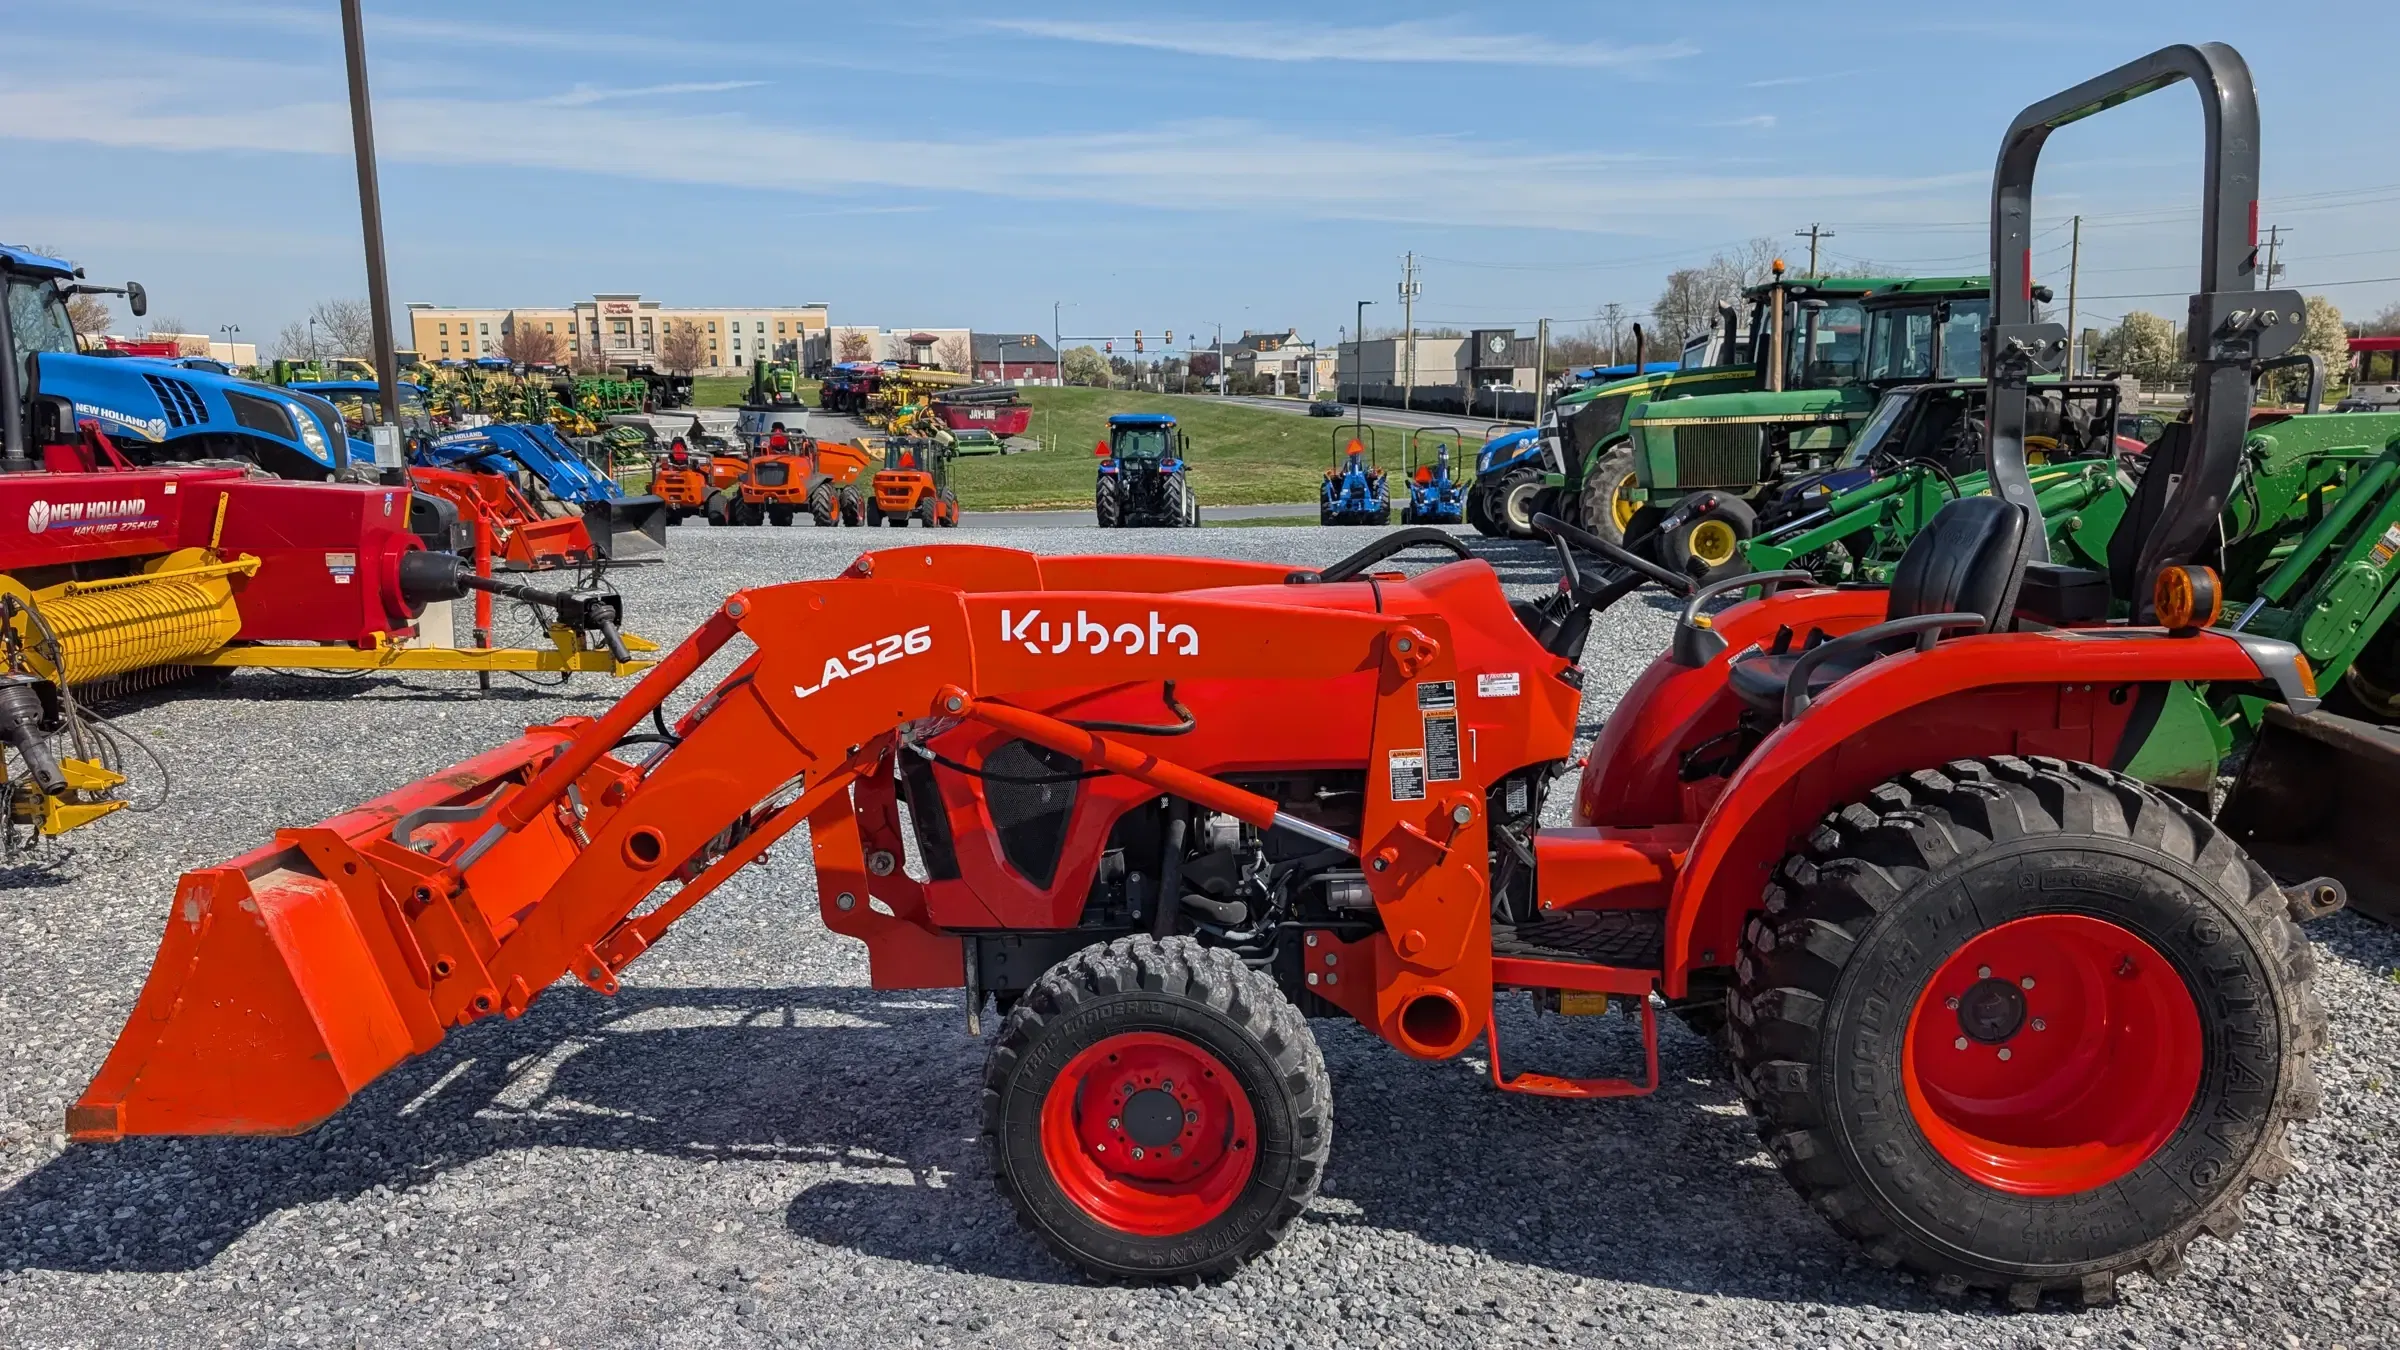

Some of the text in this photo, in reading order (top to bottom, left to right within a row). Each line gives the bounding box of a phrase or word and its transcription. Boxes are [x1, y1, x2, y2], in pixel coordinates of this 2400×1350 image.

[75, 402, 148, 429] NEW HOLLAND
[969, 409, 996, 420] JAY-LOR
[440, 431, 483, 443] NEW HOLLAND
[50, 499, 146, 521] NEW HOLLAND
[73, 524, 118, 536] HAYLINER
[1001, 609, 1199, 656] Kubota
[793, 625, 932, 698] LA526
[2201, 950, 2274, 1162] TITAN
